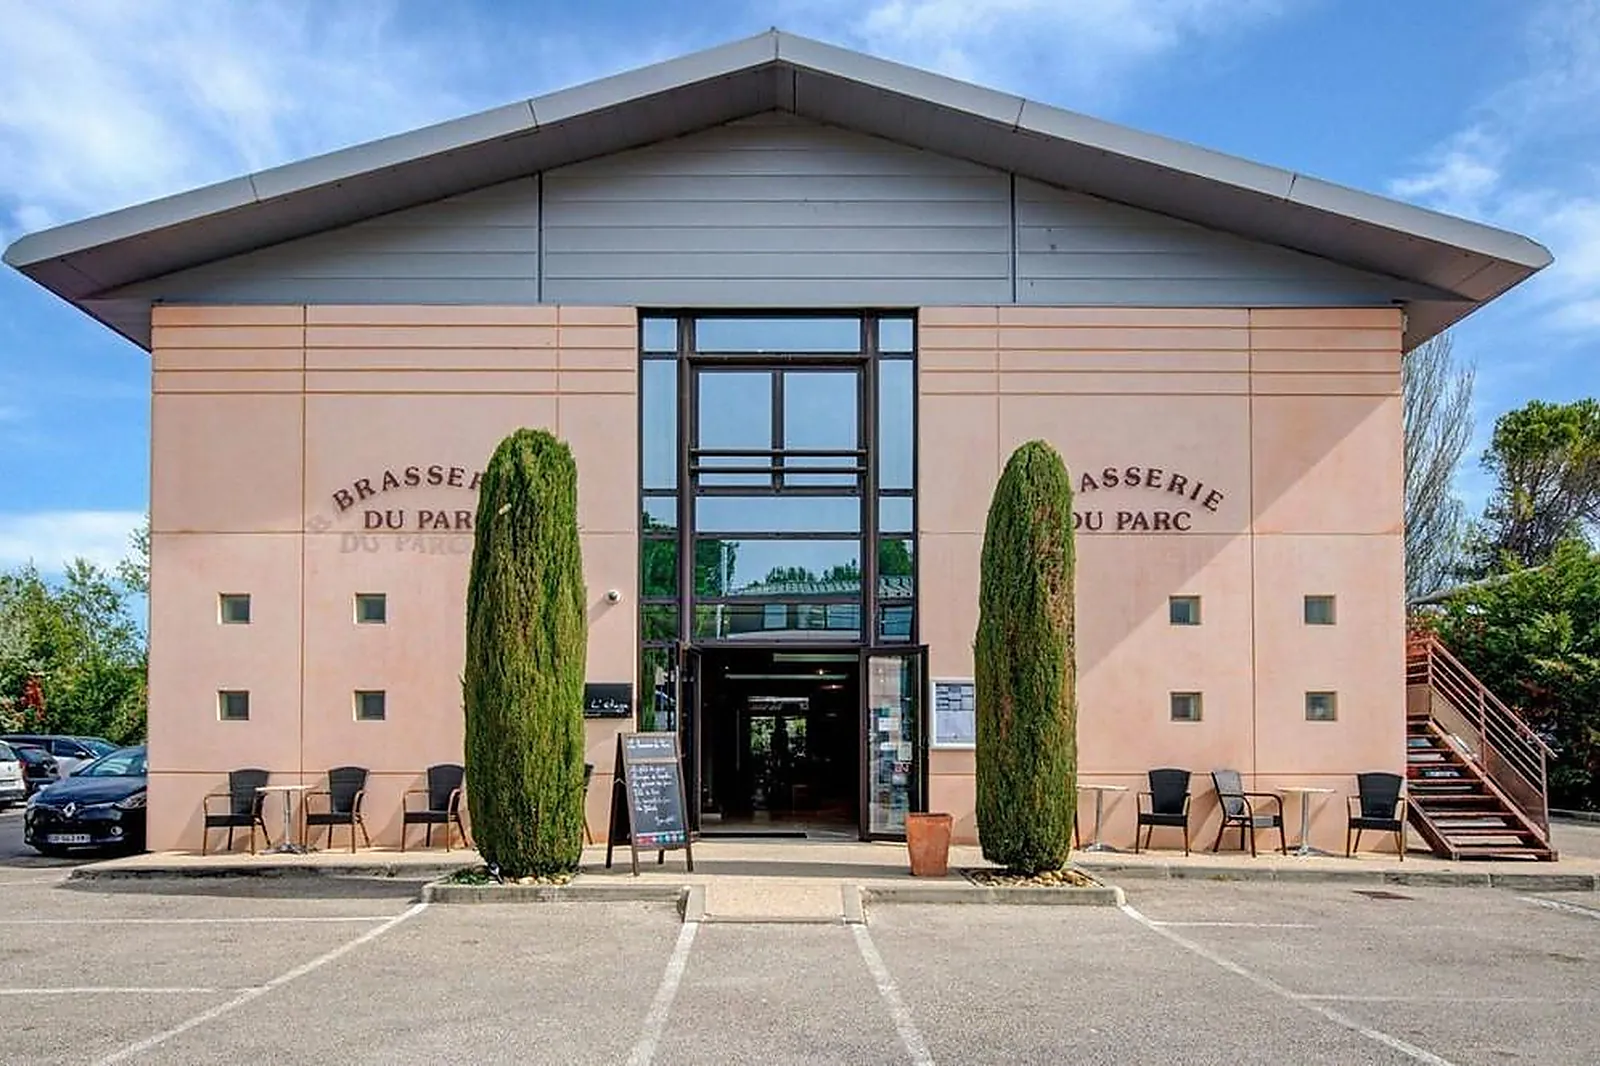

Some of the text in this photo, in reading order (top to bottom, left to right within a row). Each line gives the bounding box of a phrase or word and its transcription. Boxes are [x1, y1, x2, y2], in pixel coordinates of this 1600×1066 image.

[1079, 466, 1225, 512] ASSERIE
[363, 510, 473, 530] DU PAR
[1116, 511, 1192, 531] PARC
